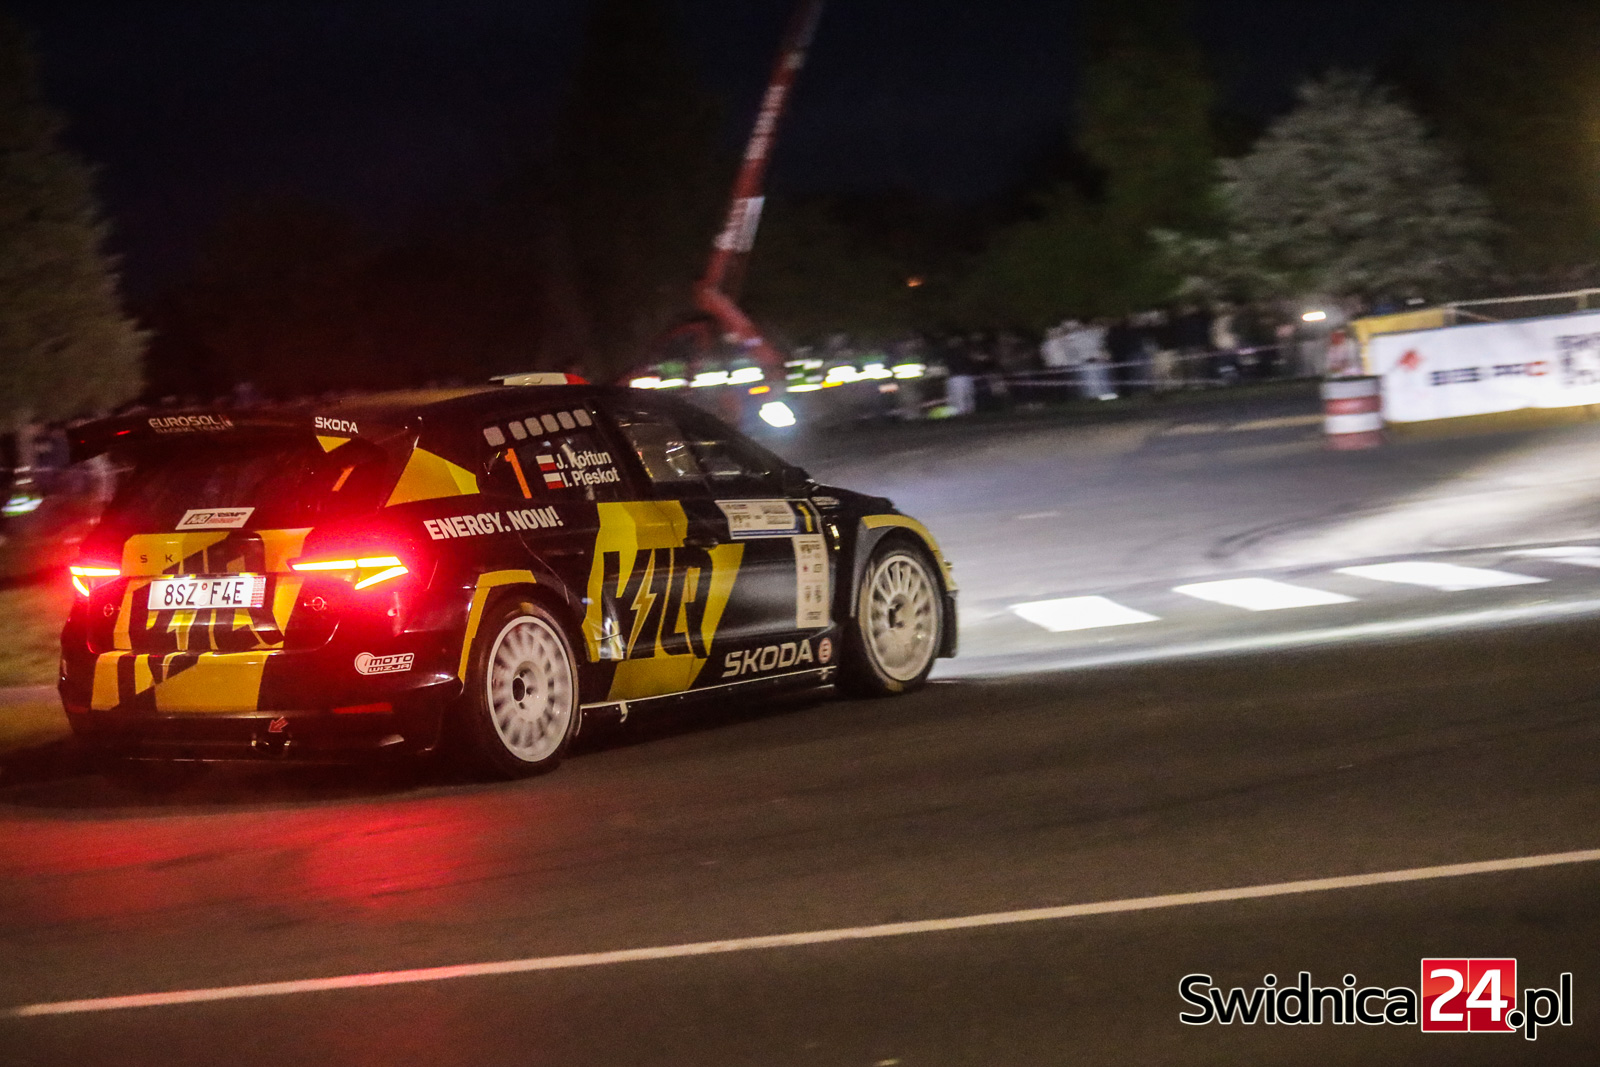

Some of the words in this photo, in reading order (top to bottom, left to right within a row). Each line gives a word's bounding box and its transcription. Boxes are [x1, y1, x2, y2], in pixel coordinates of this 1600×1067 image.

[148, 415, 220, 428] EUROSOL
[315, 416, 358, 434] SKODA
[556, 453, 569, 470] J.
[331, 465, 357, 492] 1
[504, 448, 533, 499] 1
[423, 512, 511, 541] ENERGY.
[506, 506, 564, 531] NOW!
[164, 583, 198, 606] 8SZ
[209, 581, 245, 604] F4E
[368, 663, 410, 673] WIZJA
[369, 654, 413, 666] MOTO
[722, 639, 814, 678] SKODA
